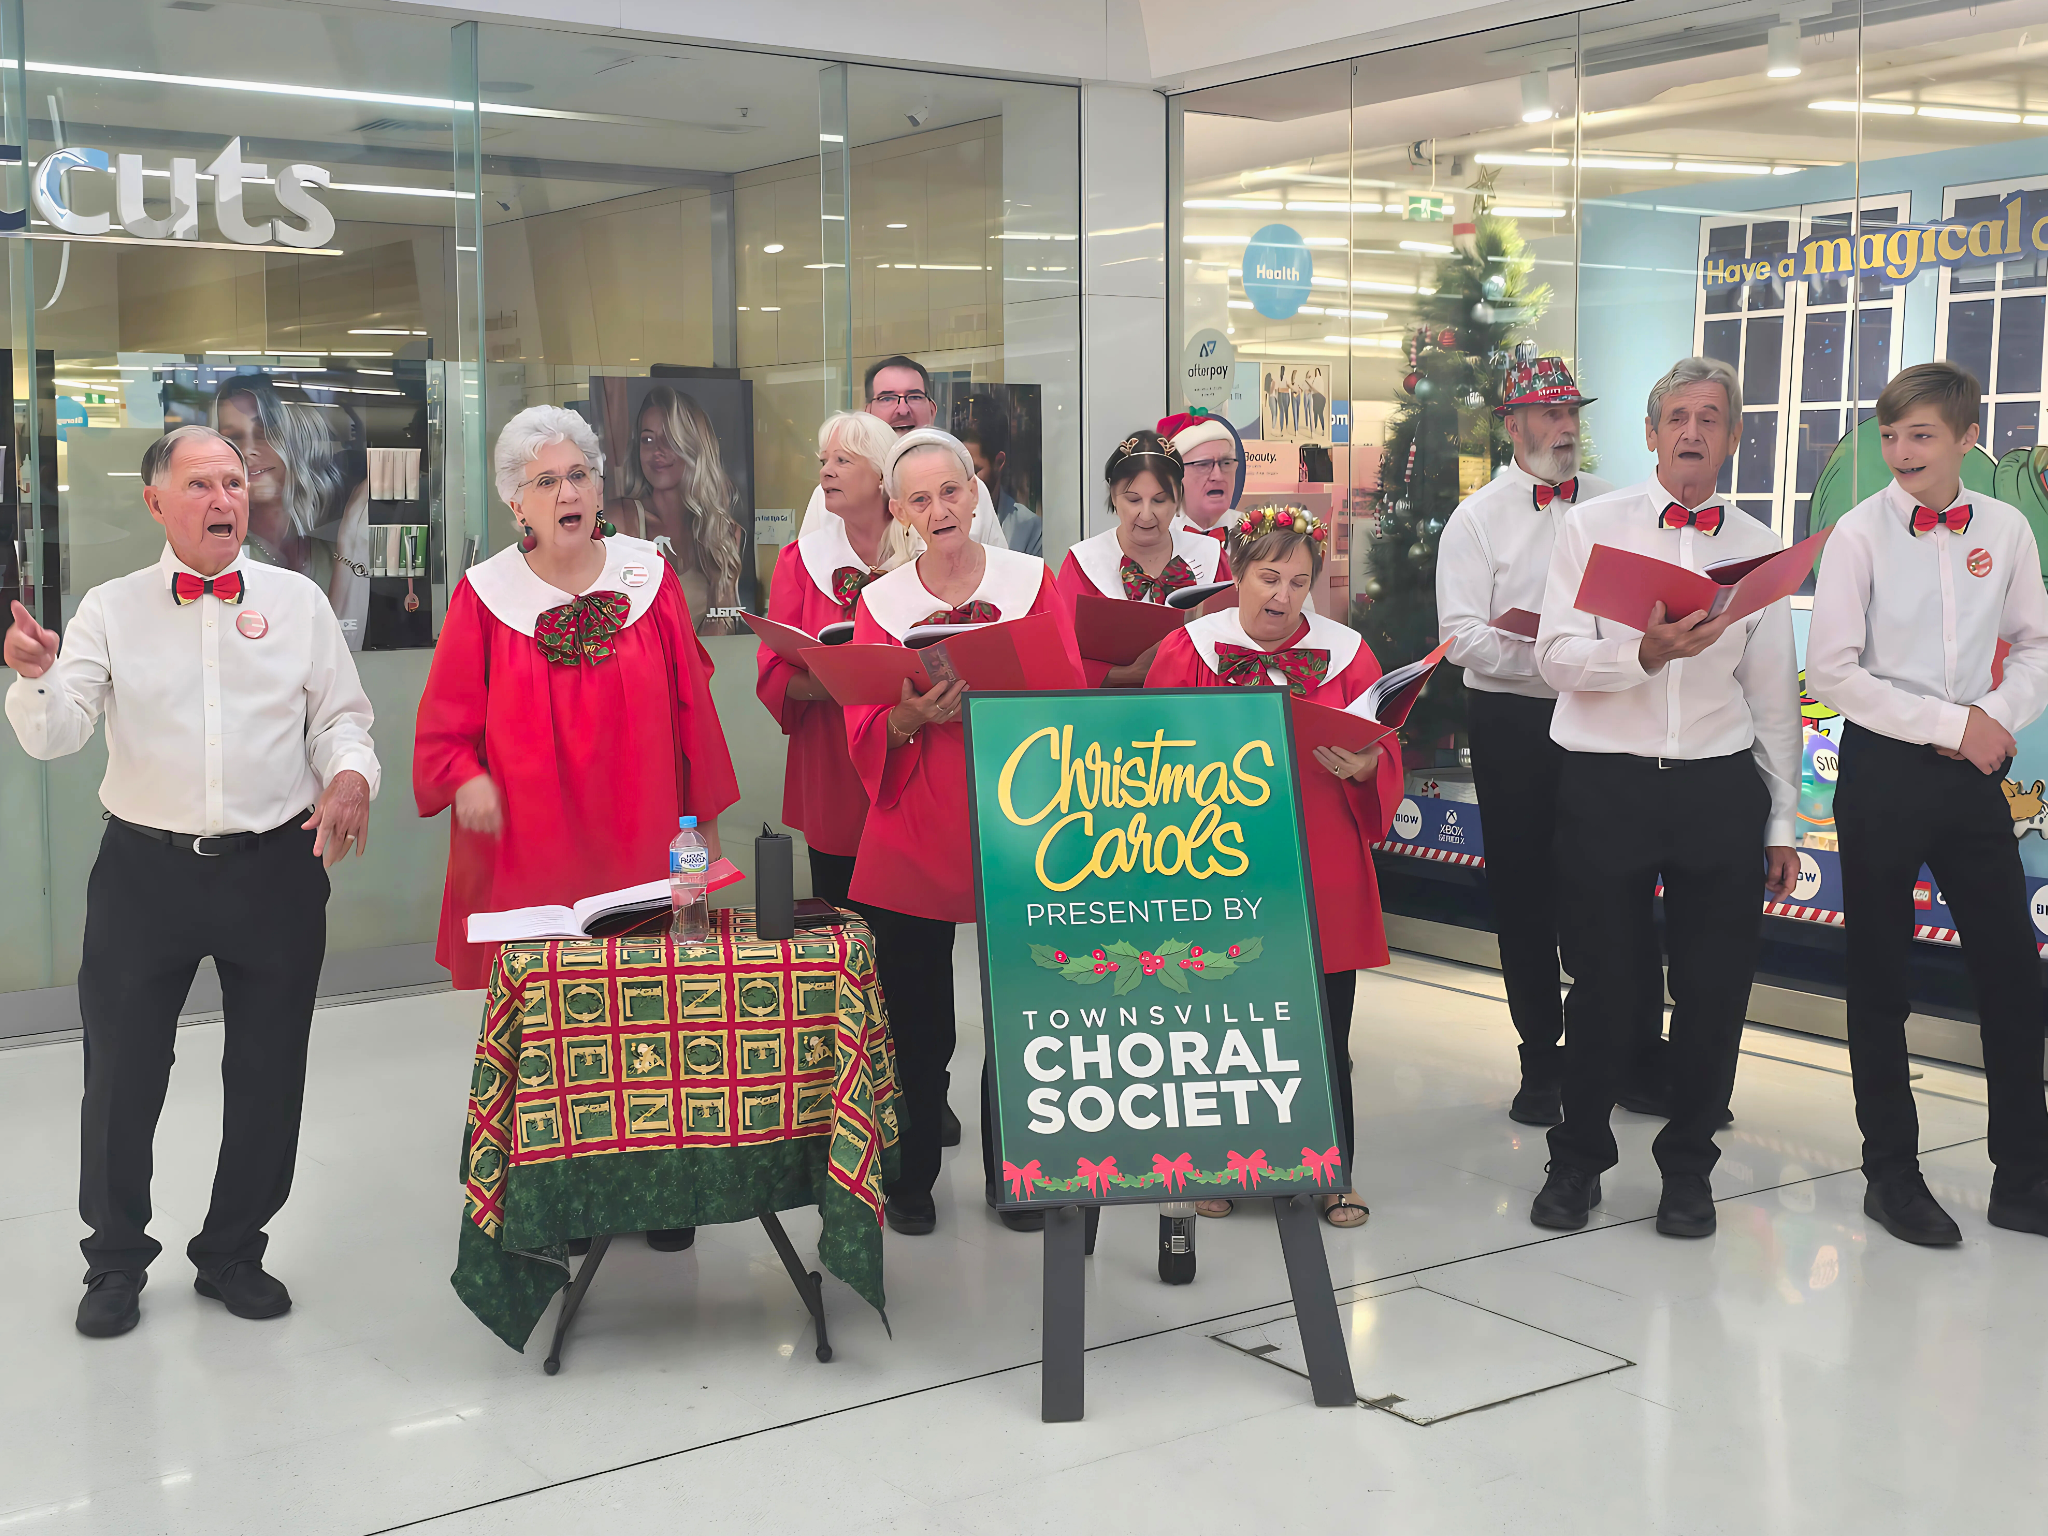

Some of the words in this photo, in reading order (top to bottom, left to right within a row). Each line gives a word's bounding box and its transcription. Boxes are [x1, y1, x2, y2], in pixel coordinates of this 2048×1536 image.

[31, 136, 336, 248] cuts
[1707, 258, 1771, 285] Have
[1777, 257, 1795, 278] a
[1801, 196, 2023, 279] magical
[1256, 264, 1300, 282] Health
[1187, 363, 1229, 380] afterpay
[998, 724, 1275, 826] Christmas
[1035, 804, 1250, 892] Carols
[1026, 899, 1212, 926] PRESENTED
[1223, 896, 1263, 920] BY
[1022, 1001, 1291, 1030] TOWNSVILLE
[1023, 1028, 1300, 1082] CHORAL
[1027, 1077, 1302, 1134] SOCIETY
